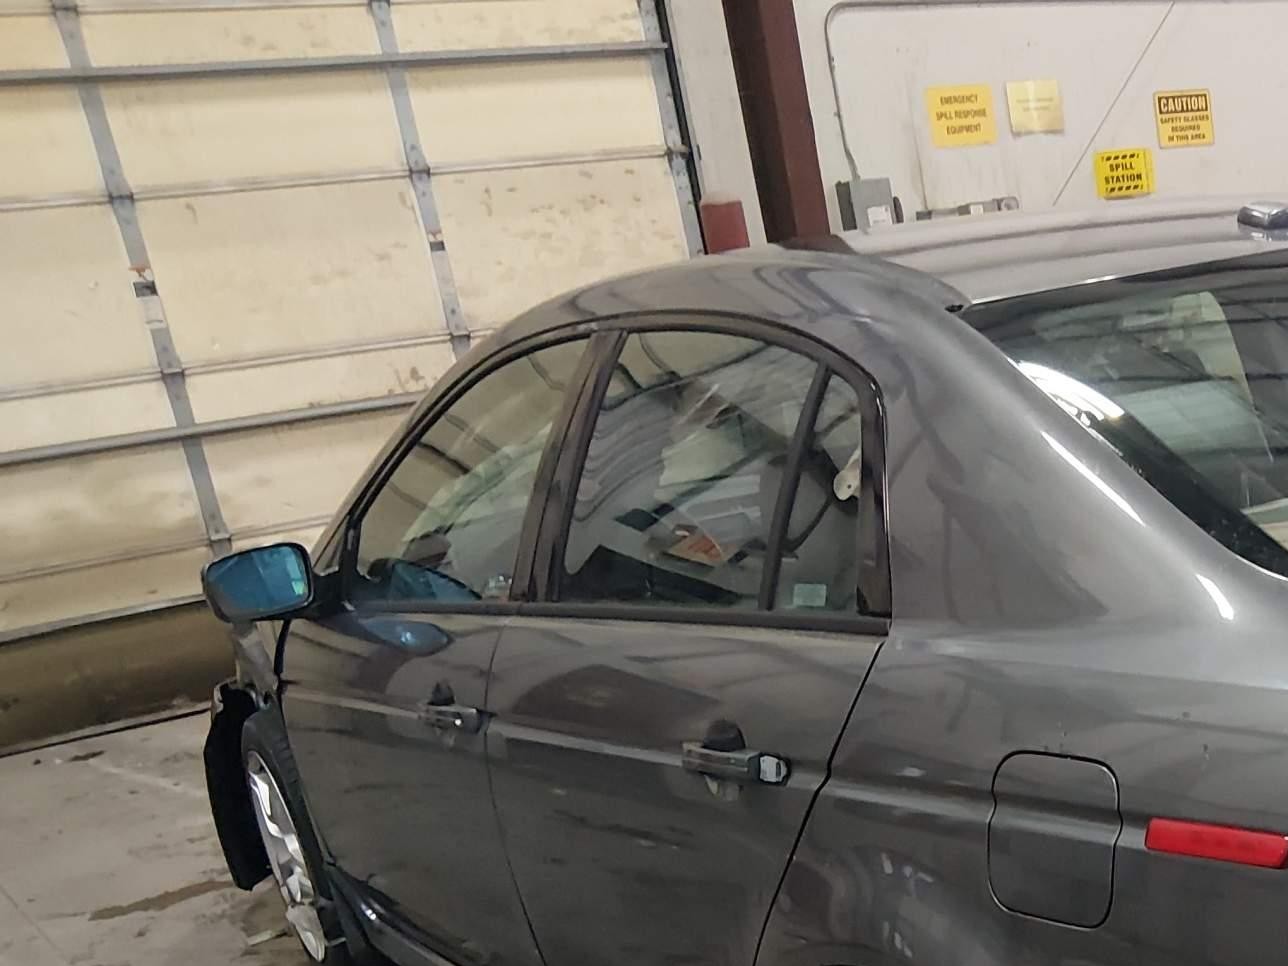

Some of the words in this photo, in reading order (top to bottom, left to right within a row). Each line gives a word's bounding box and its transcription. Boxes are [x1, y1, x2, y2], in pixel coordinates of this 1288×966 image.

[940, 94, 978, 105] EMERGENCY
[1160, 96, 1206, 112] CAUTION
[935, 110, 954, 121] SPILL
[955, 107, 987, 119] RESPONSE
[1160, 116, 1182, 124] SAFETY
[1183, 114, 1209, 123] GLASSES
[946, 123, 982, 135] EQUIPMENT
[1109, 162, 1135, 172] SPILL
[1104, 172, 1143, 185] STATION
